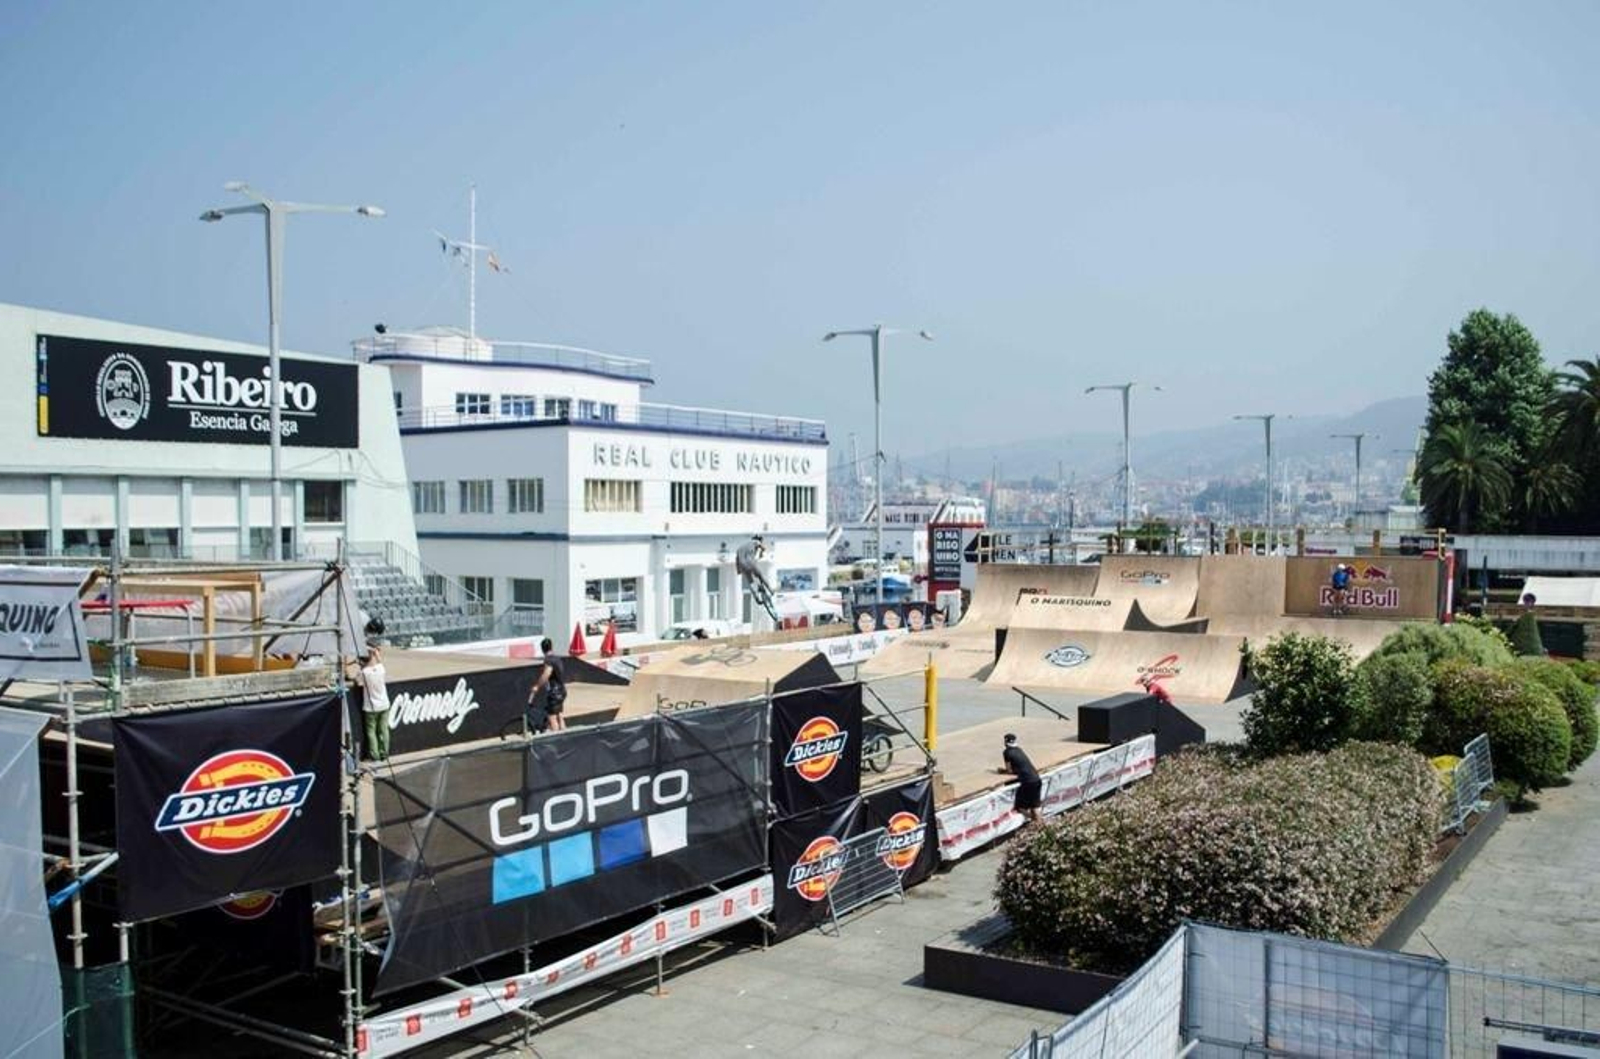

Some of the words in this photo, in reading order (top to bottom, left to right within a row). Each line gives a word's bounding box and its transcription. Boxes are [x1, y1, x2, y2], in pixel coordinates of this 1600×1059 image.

[166, 360, 317, 411] Ribeiro
[190, 411, 248, 431] Esencia
[250, 415, 299, 436] Gaga
[592, 442, 651, 467] REAL
[670, 449, 720, 471] CLUB
[736, 452, 811, 474] NAUTICO
[1120, 570, 1171, 579] GoPro
[1321, 587, 1359, 606] Rd
[1361, 588, 1398, 607] Bull
[659, 697, 708, 711] GoP
[792, 737, 842, 761] Dickies
[173, 783, 299, 822] Dickies
[488, 768, 690, 847] GoPro
